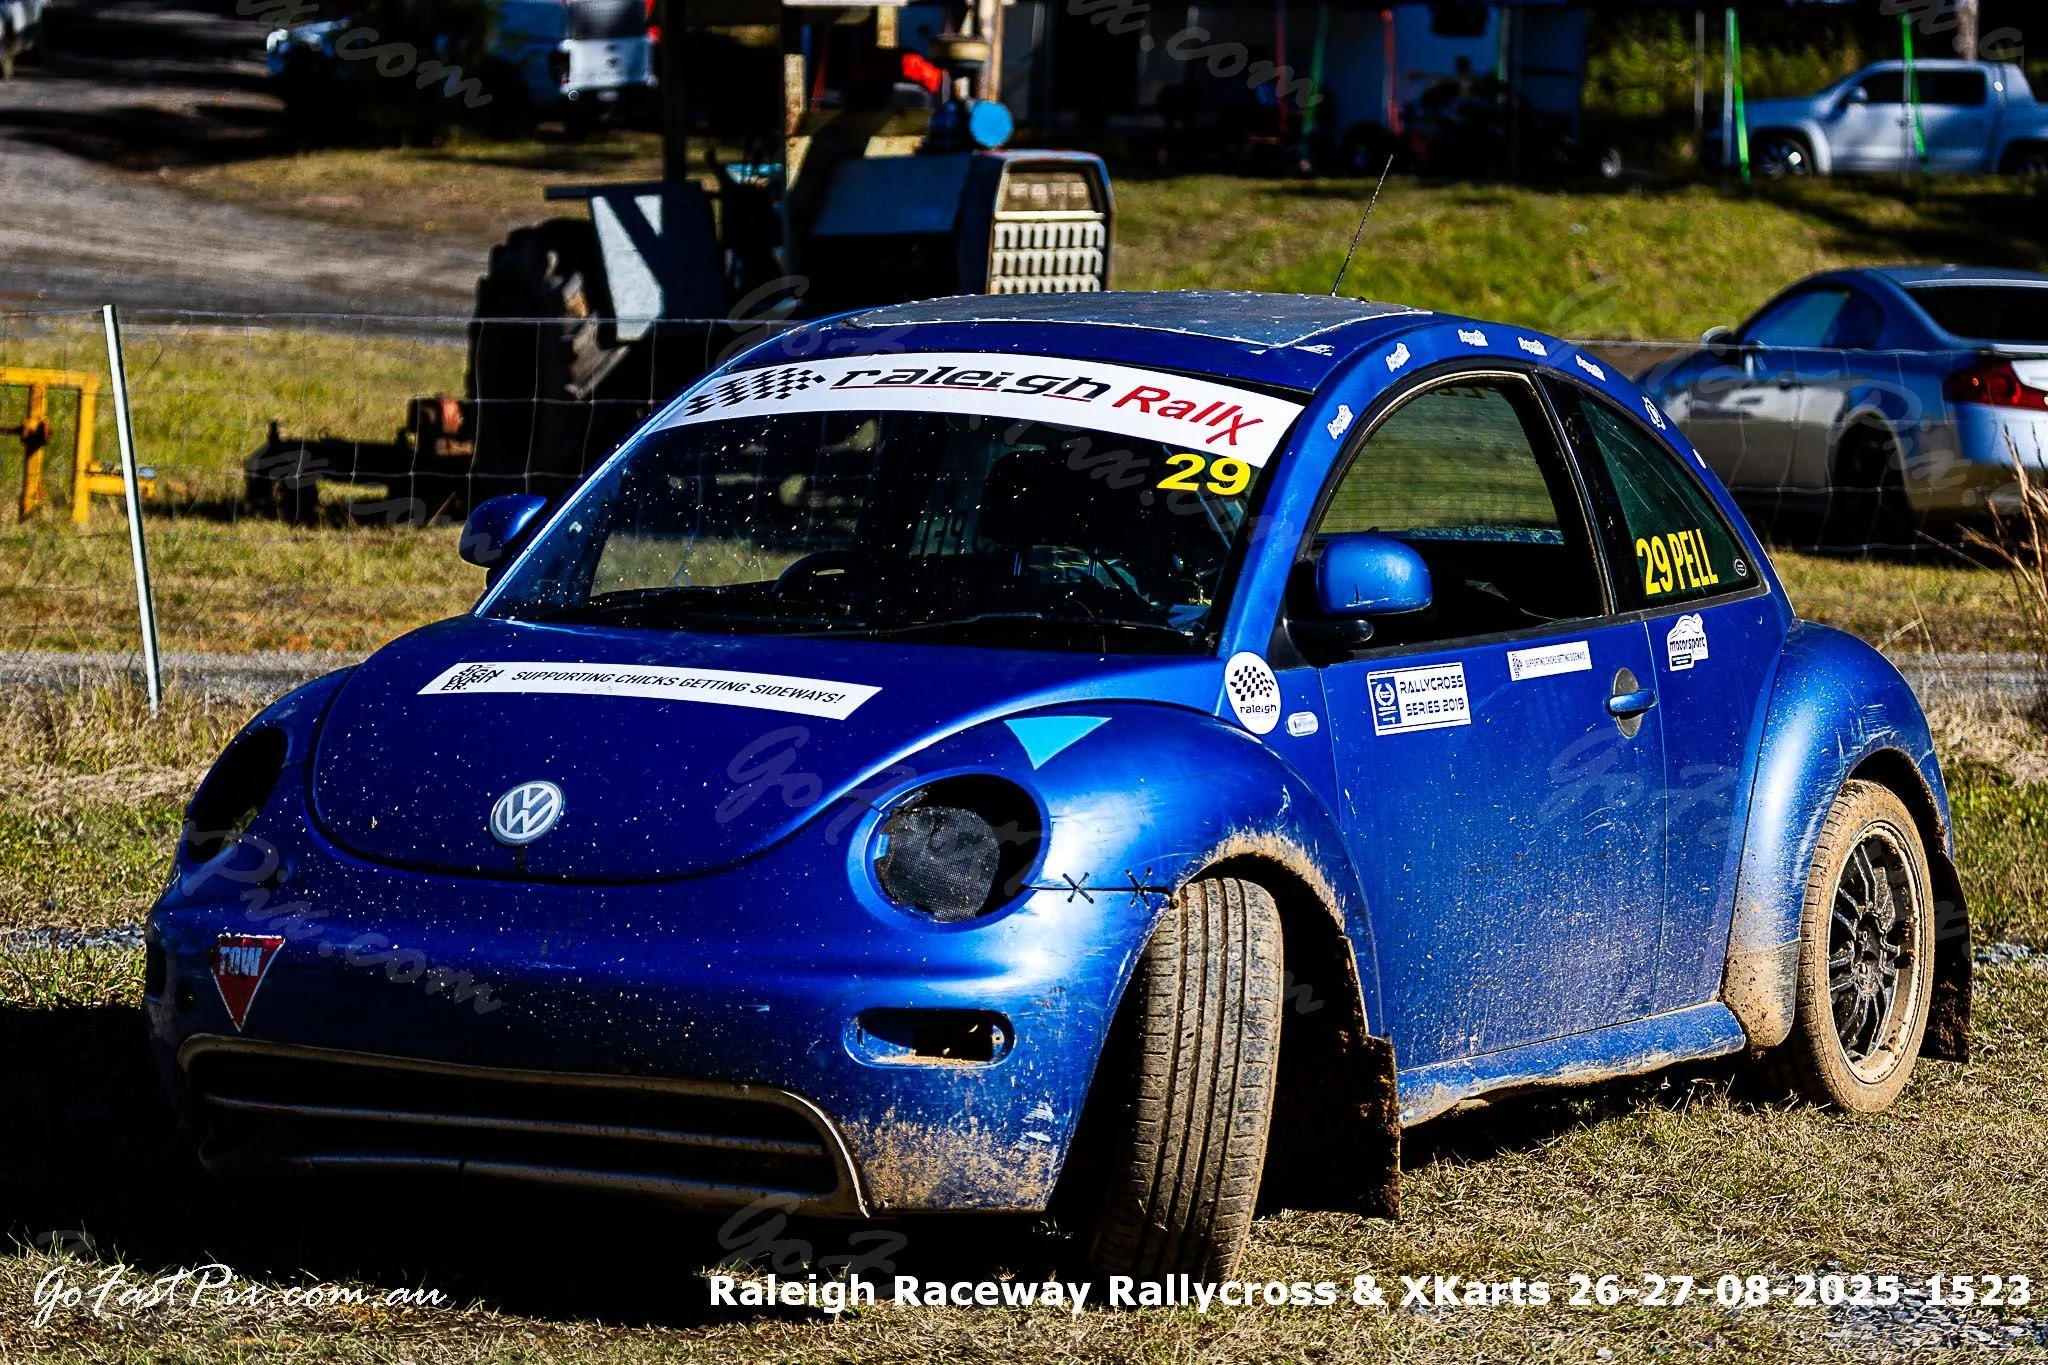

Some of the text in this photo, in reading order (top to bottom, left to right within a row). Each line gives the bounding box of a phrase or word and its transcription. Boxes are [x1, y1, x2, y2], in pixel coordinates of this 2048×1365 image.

[831, 366, 1112, 400] raleigh
[1156, 453, 1251, 496] 29
[1636, 529, 1719, 595] 29 PELL
[1669, 636, 1706, 653] motorsport
[511, 671, 847, 704] SUPPORTING CHICKS GETTING SIDEWAYS!
[1399, 674, 1465, 694] RALLYCROSS
[1239, 703, 1277, 714] raleigh
[1405, 697, 1466, 716] SERIES 2019
[494, 783, 561, 840] VW
[218, 945, 263, 977] TOW
